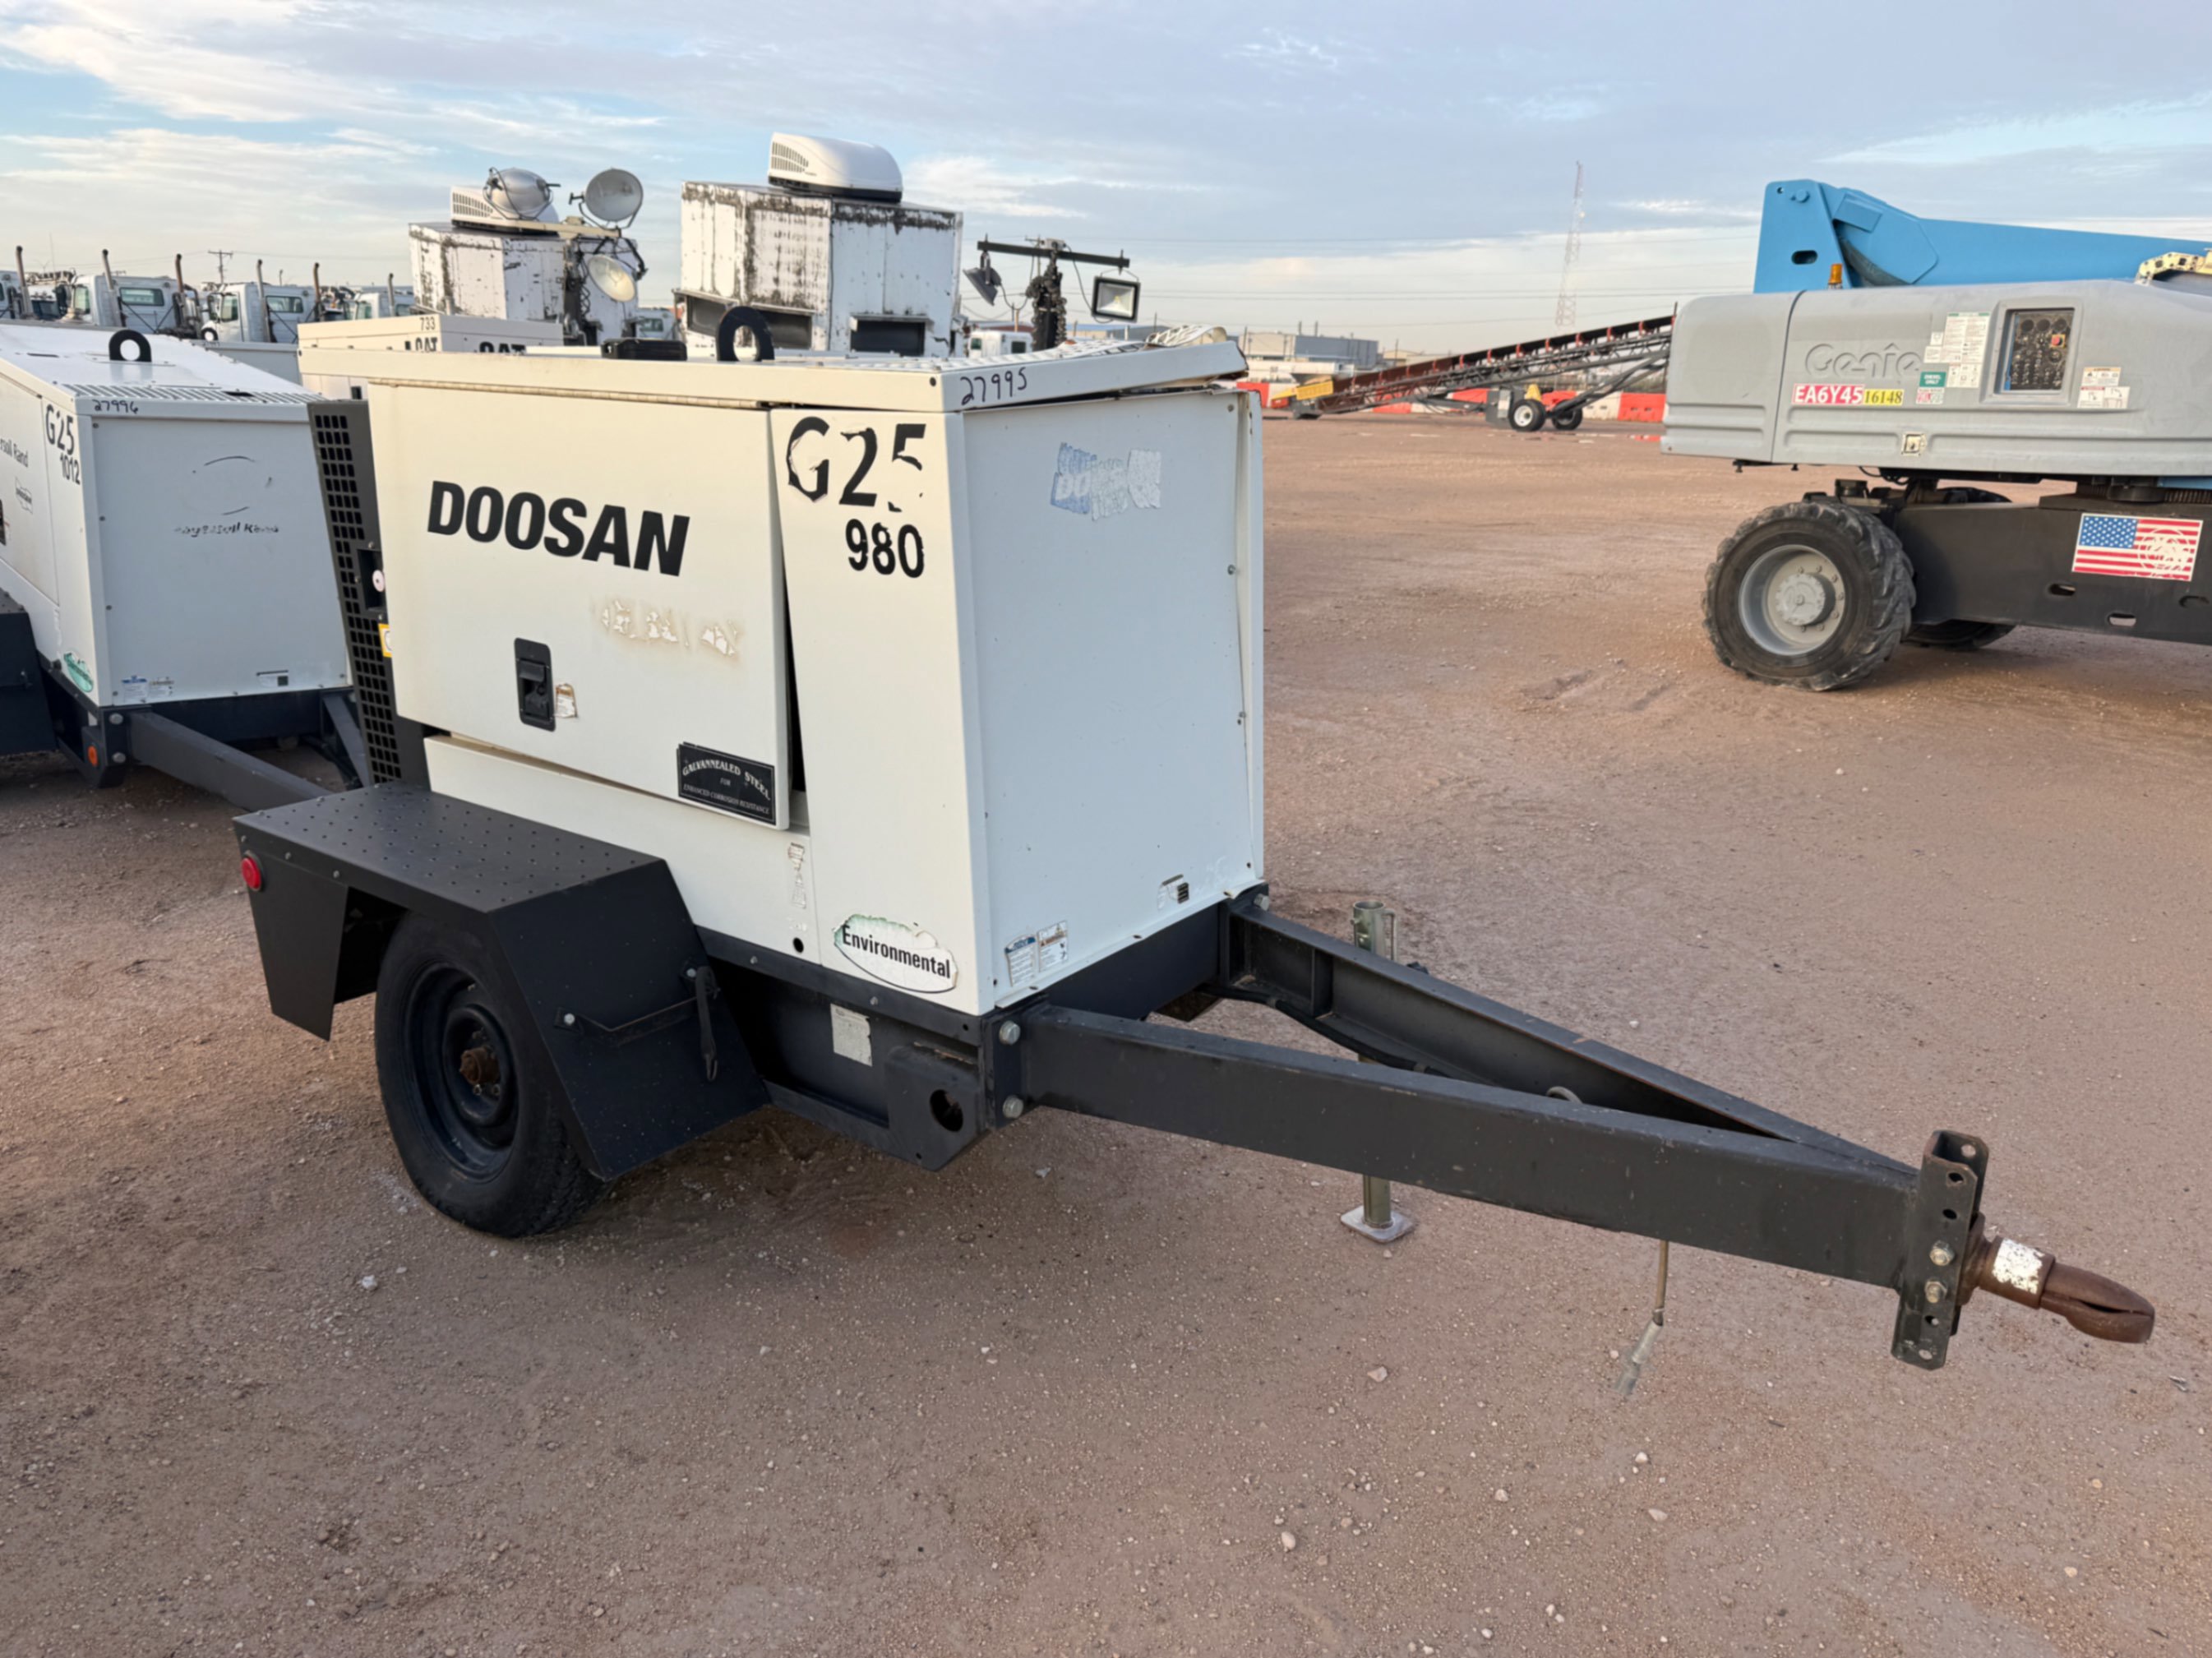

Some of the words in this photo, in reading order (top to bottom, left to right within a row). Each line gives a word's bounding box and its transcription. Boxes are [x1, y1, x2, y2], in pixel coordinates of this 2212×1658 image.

[419, 317, 436, 330] 733
[1805, 343, 1922, 378] Genie
[960, 367, 1027, 406] 27995
[1794, 385, 1863, 404] EA6Y45
[1864, 390, 1903, 404] 16148
[92, 399, 139, 413] 27996
[45, 404, 75, 455] G25
[60, 453, 81, 485] 1012
[427, 480, 690, 577] DOOSAN
[846, 519, 925, 578] 980
[682, 759, 741, 777] GALVANNEALED
[744, 771, 771, 801] STEEL
[842, 924, 951, 979] Environmental
